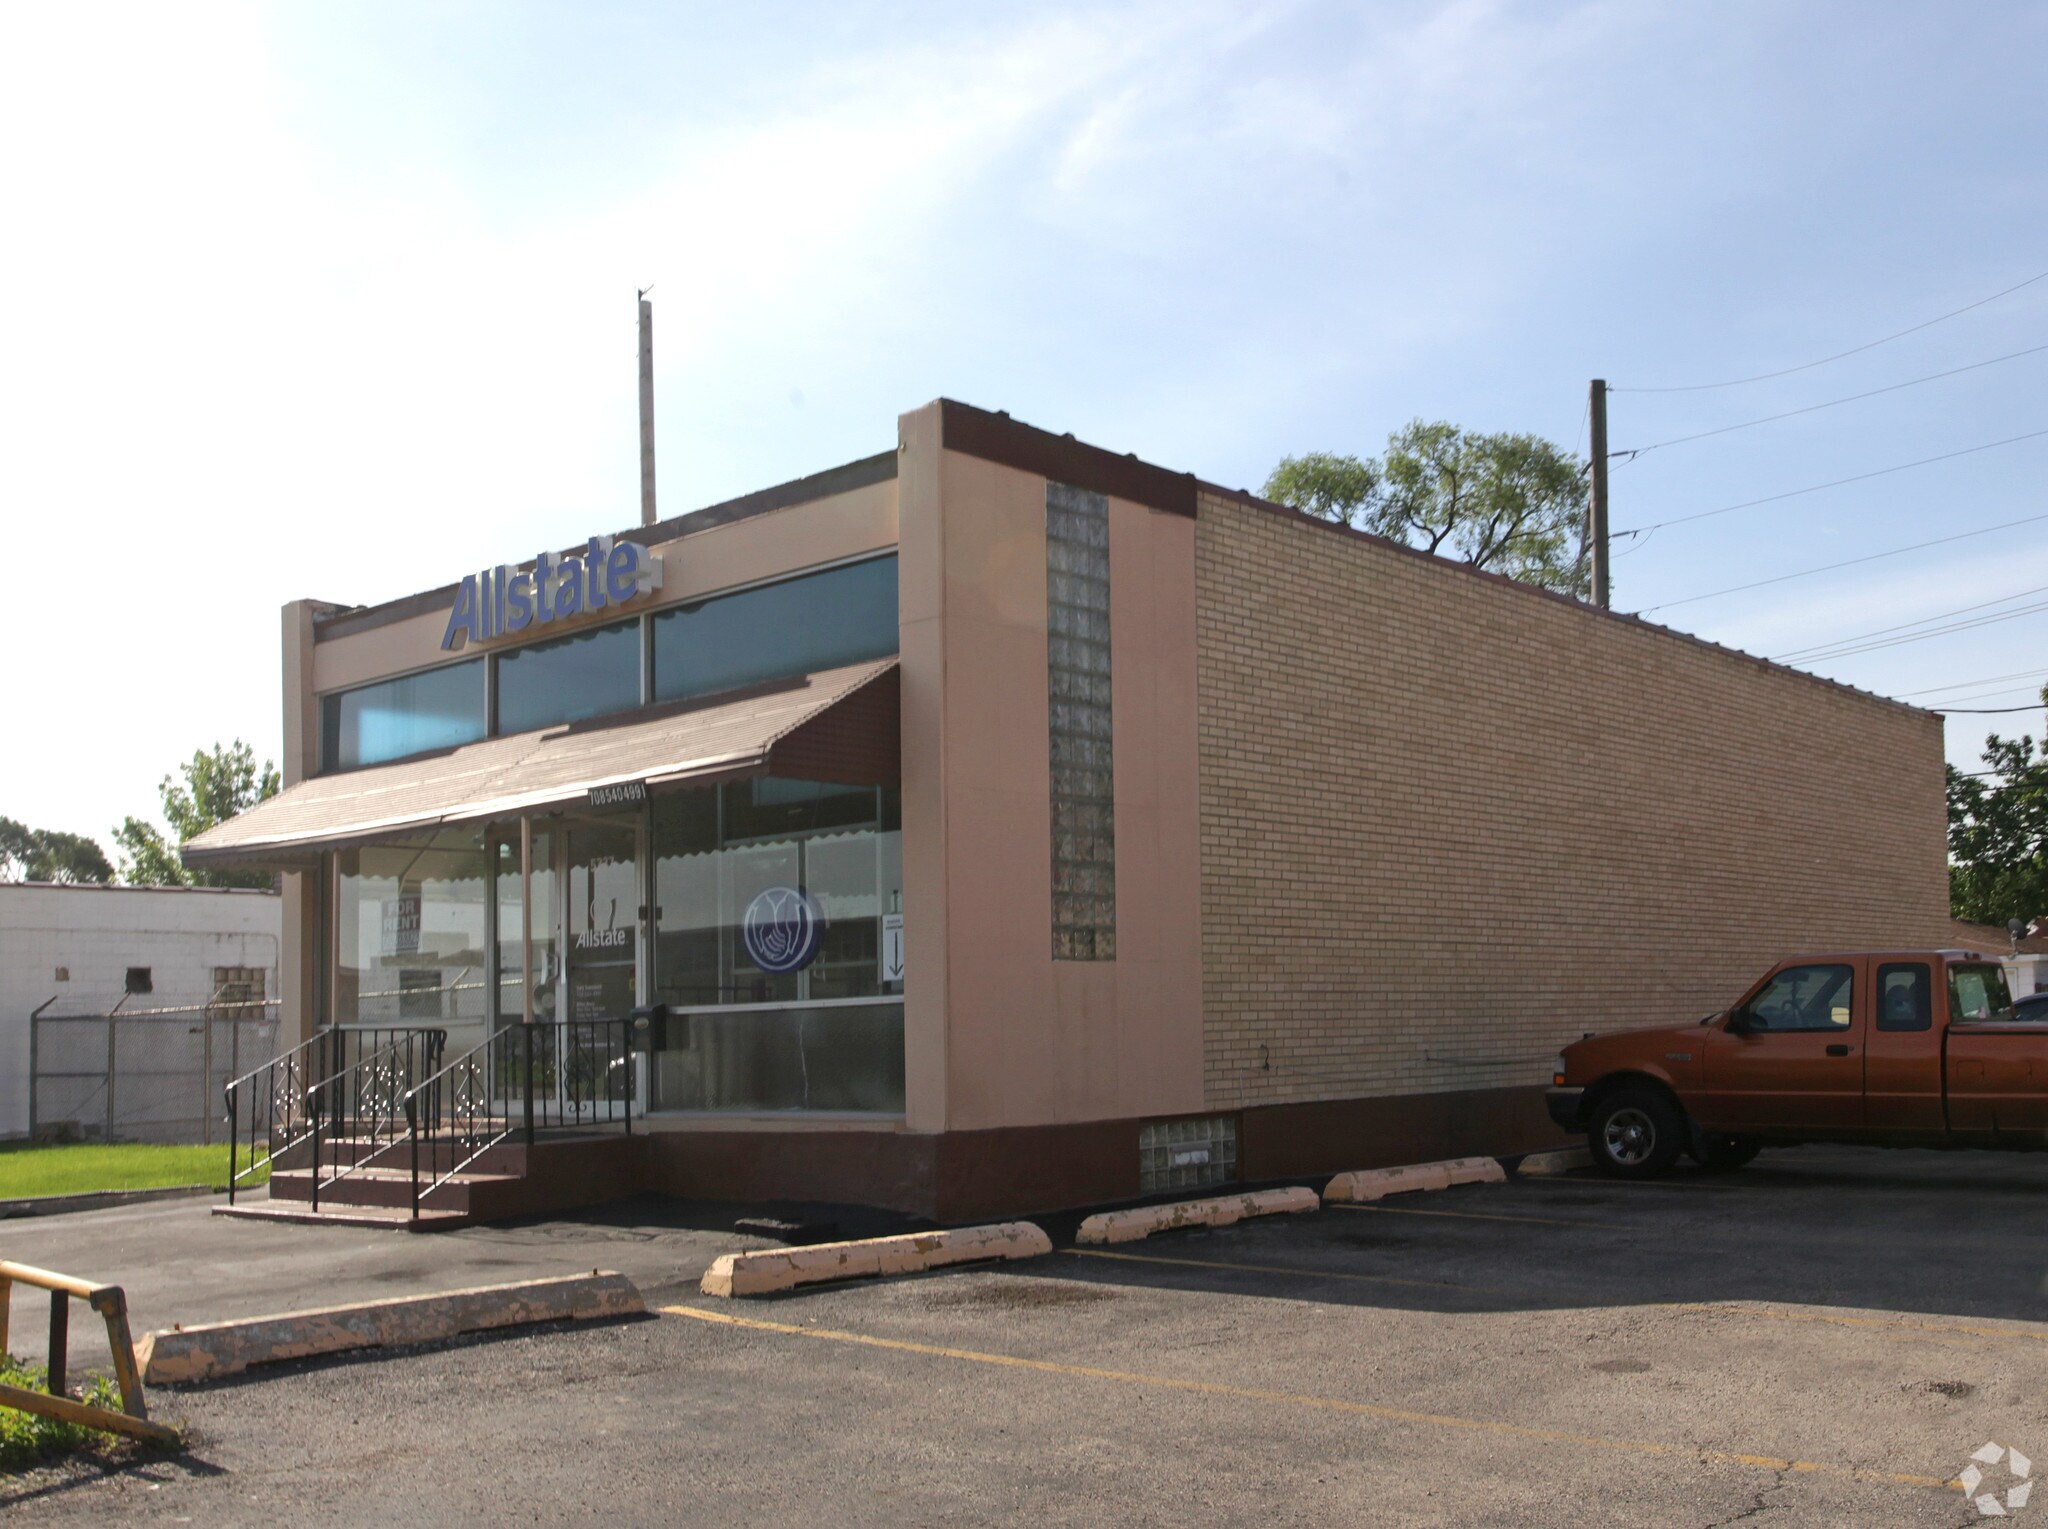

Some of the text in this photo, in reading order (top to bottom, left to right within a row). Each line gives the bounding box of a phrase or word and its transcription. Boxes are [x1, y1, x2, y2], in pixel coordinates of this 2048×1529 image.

[441, 536, 641, 651] Allstate
[589, 784, 646, 806] 7085404991
[387, 900, 415, 916] FOR
[383, 914, 419, 931] RENT
[576, 927, 626, 949] Allstate
